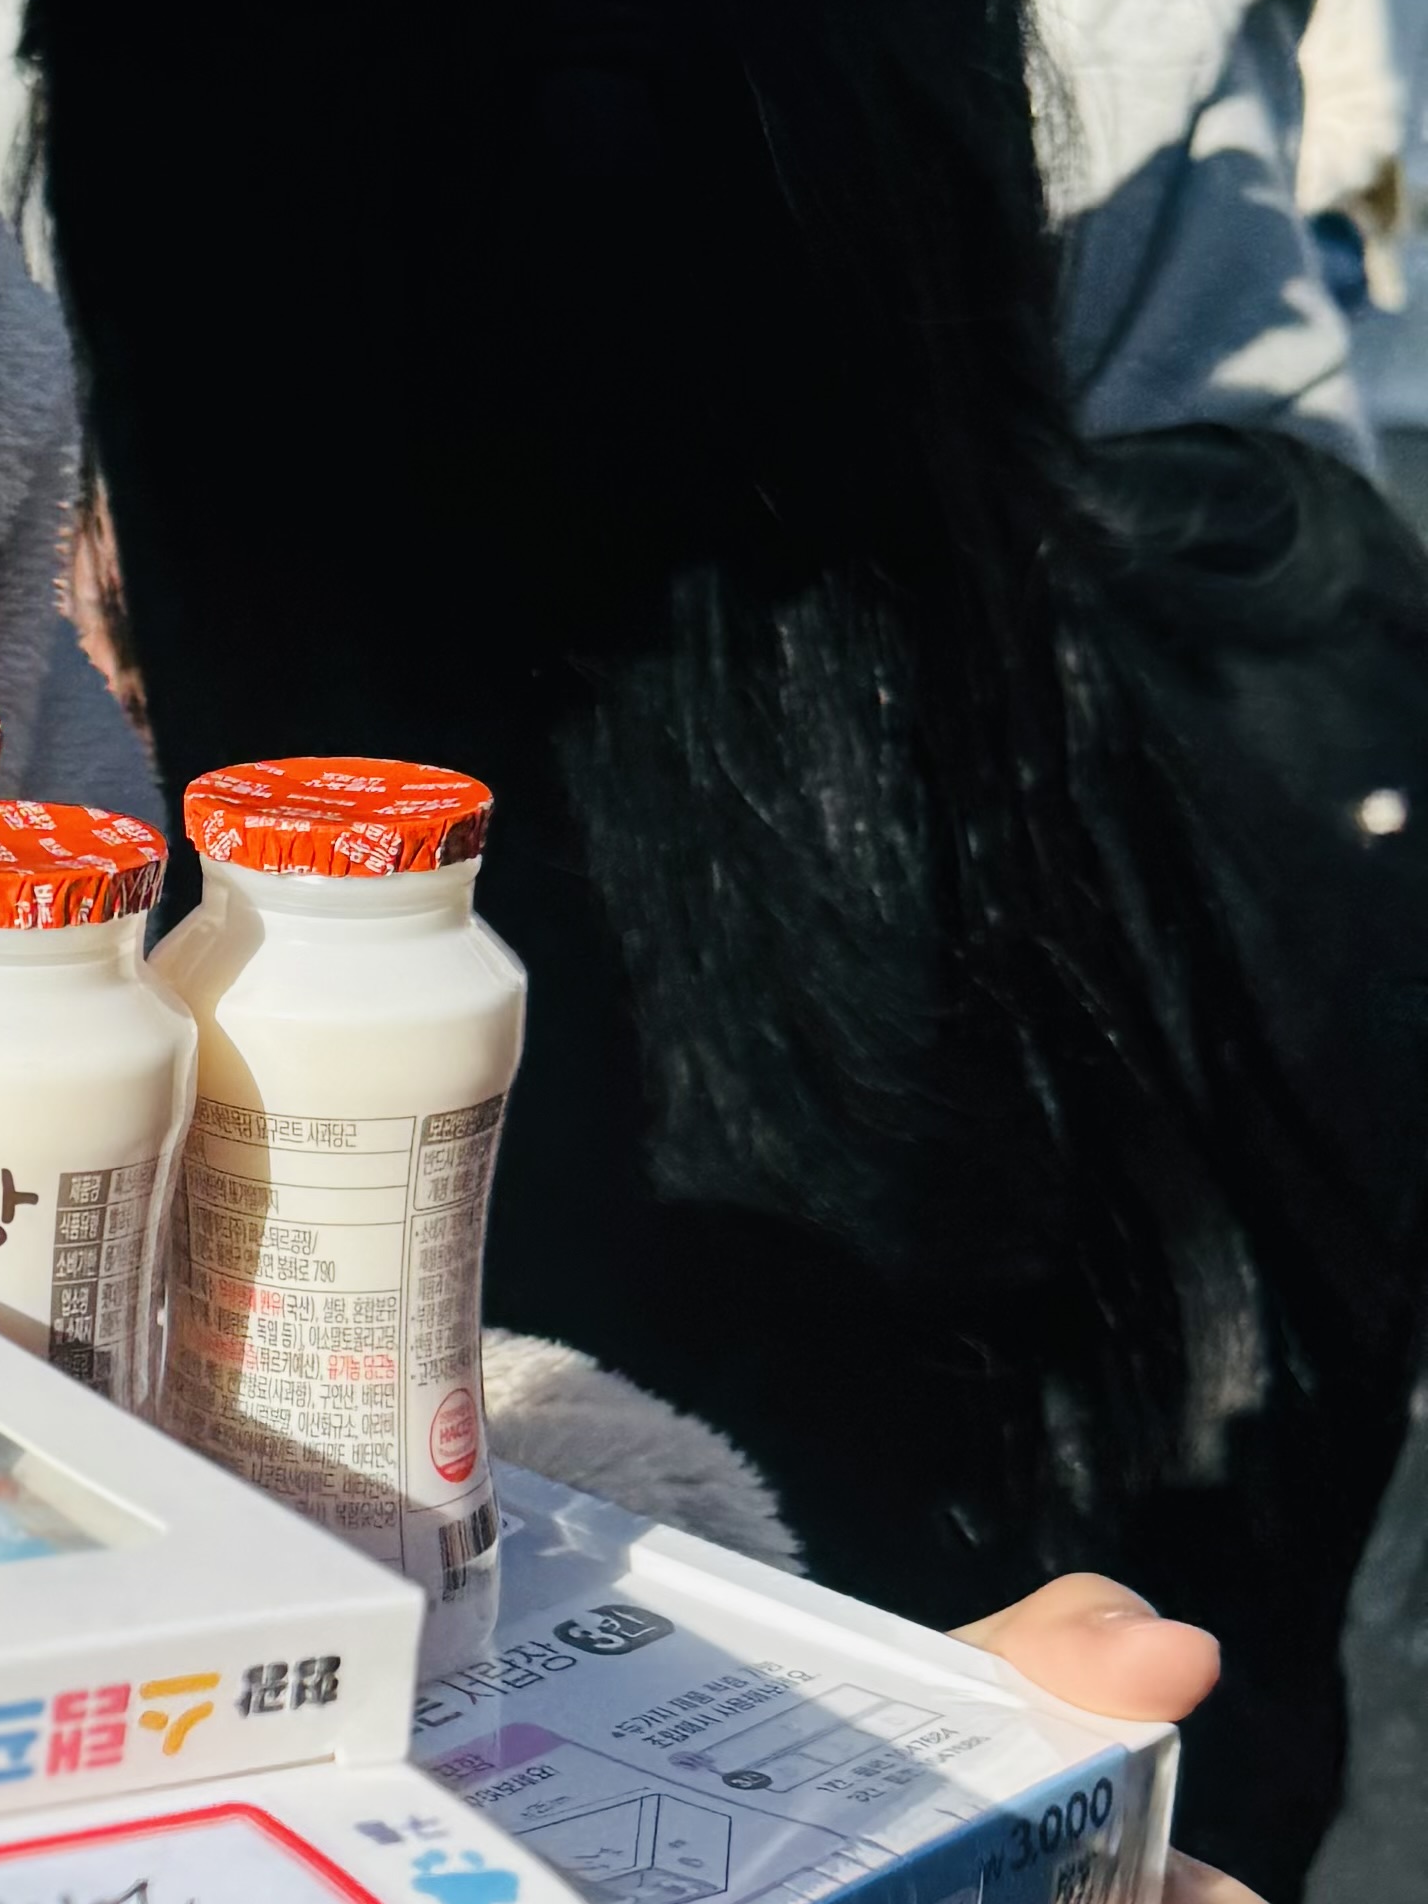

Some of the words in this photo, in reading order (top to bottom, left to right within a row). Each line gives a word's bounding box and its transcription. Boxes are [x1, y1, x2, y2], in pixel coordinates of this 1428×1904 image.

[306, 1120, 358, 1148] 사과당근
[313, 1260, 336, 1284] 790
[239, 1654, 343, 1717] 형광
[434, 1640, 579, 1706] 서랍장
